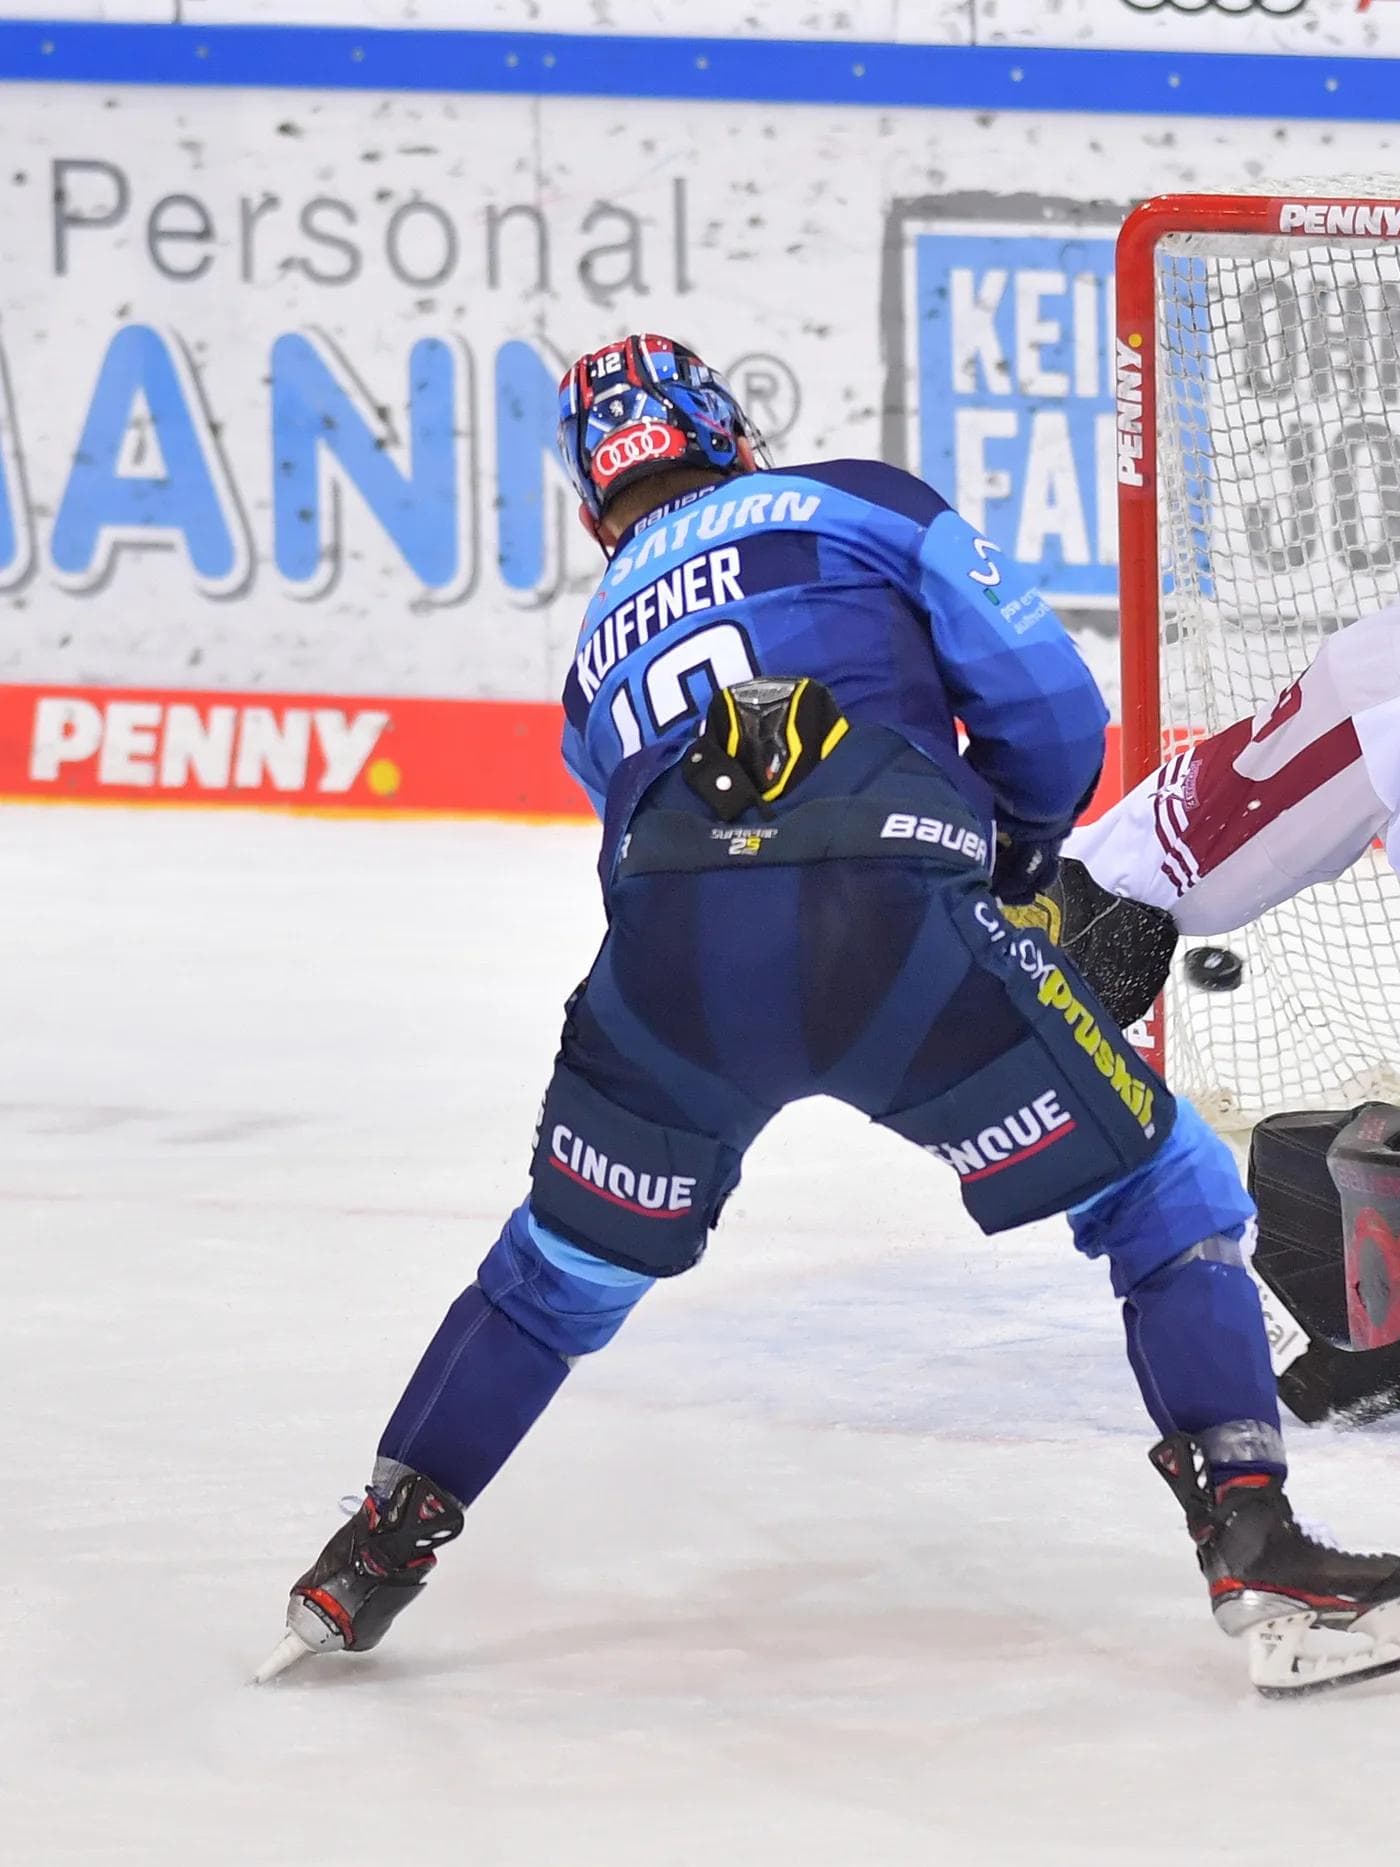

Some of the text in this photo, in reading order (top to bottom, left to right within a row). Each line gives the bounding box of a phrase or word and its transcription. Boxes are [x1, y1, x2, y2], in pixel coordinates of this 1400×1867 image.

[51, 157, 696, 296] Personal
[596, 351, 622, 378] 12
[950, 267, 1117, 399] KEI
[609, 491, 822, 588] SATURN
[576, 545, 746, 704] KUFFNER
[551, 1124, 697, 1211] CINQUE
